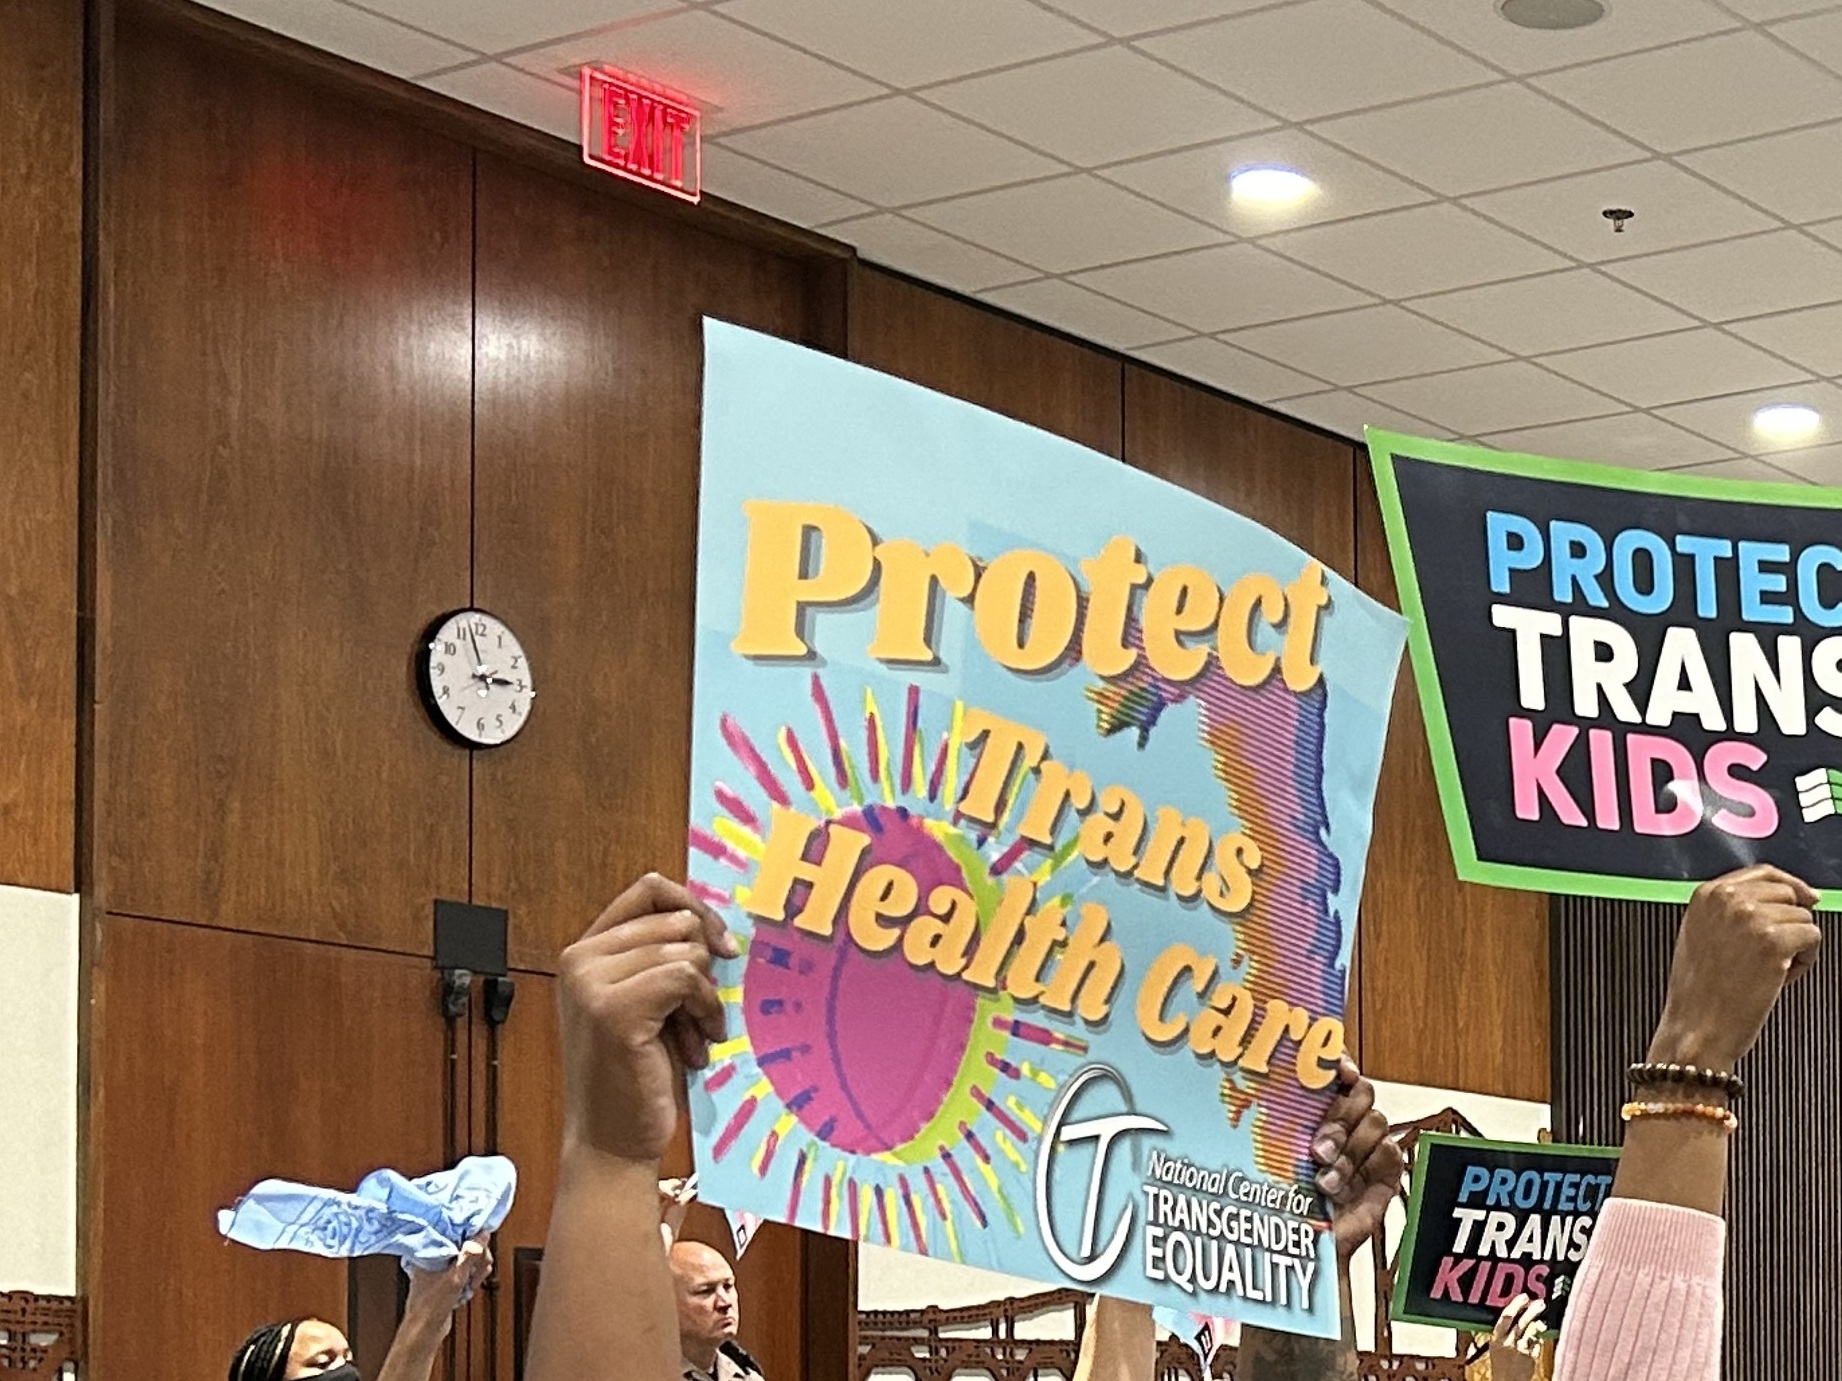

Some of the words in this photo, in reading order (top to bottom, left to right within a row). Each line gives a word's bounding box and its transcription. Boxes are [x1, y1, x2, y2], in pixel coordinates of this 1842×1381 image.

[602, 83, 691, 187] EXIT
[731, 498, 1331, 693] Protect
[456, 625, 466, 641] 11
[474, 622, 487, 637] 12
[444, 641, 456, 656] 10
[496, 634, 502, 649] 1
[436, 662, 445, 676] 9
[511, 655, 518, 669] 2
[441, 685, 450, 699] 8
[516, 679, 523, 693] 3
[457, 705, 466, 726] 7
[509, 700, 516, 715] 4
[476, 716, 485, 732] 6
[495, 713, 503, 728] 5
[1508, 716, 1779, 839] KIDS
[955, 708, 1263, 915] Trans
[746, 805, 1126, 1023] Health
[1137, 945, 1346, 1090] Care
[1147, 1151, 1226, 1195] National
[1228, 1171, 1286, 1209] Center
[1286, 1184, 1314, 1216] for
[1458, 1165, 1612, 1212] PROTECT
[1143, 1186, 1316, 1258] TRANSGENDER
[1451, 1207, 1595, 1262] TRANS
[1145, 1225, 1316, 1309] EQUALITY
[1429, 1256, 1550, 1308] KIDS
